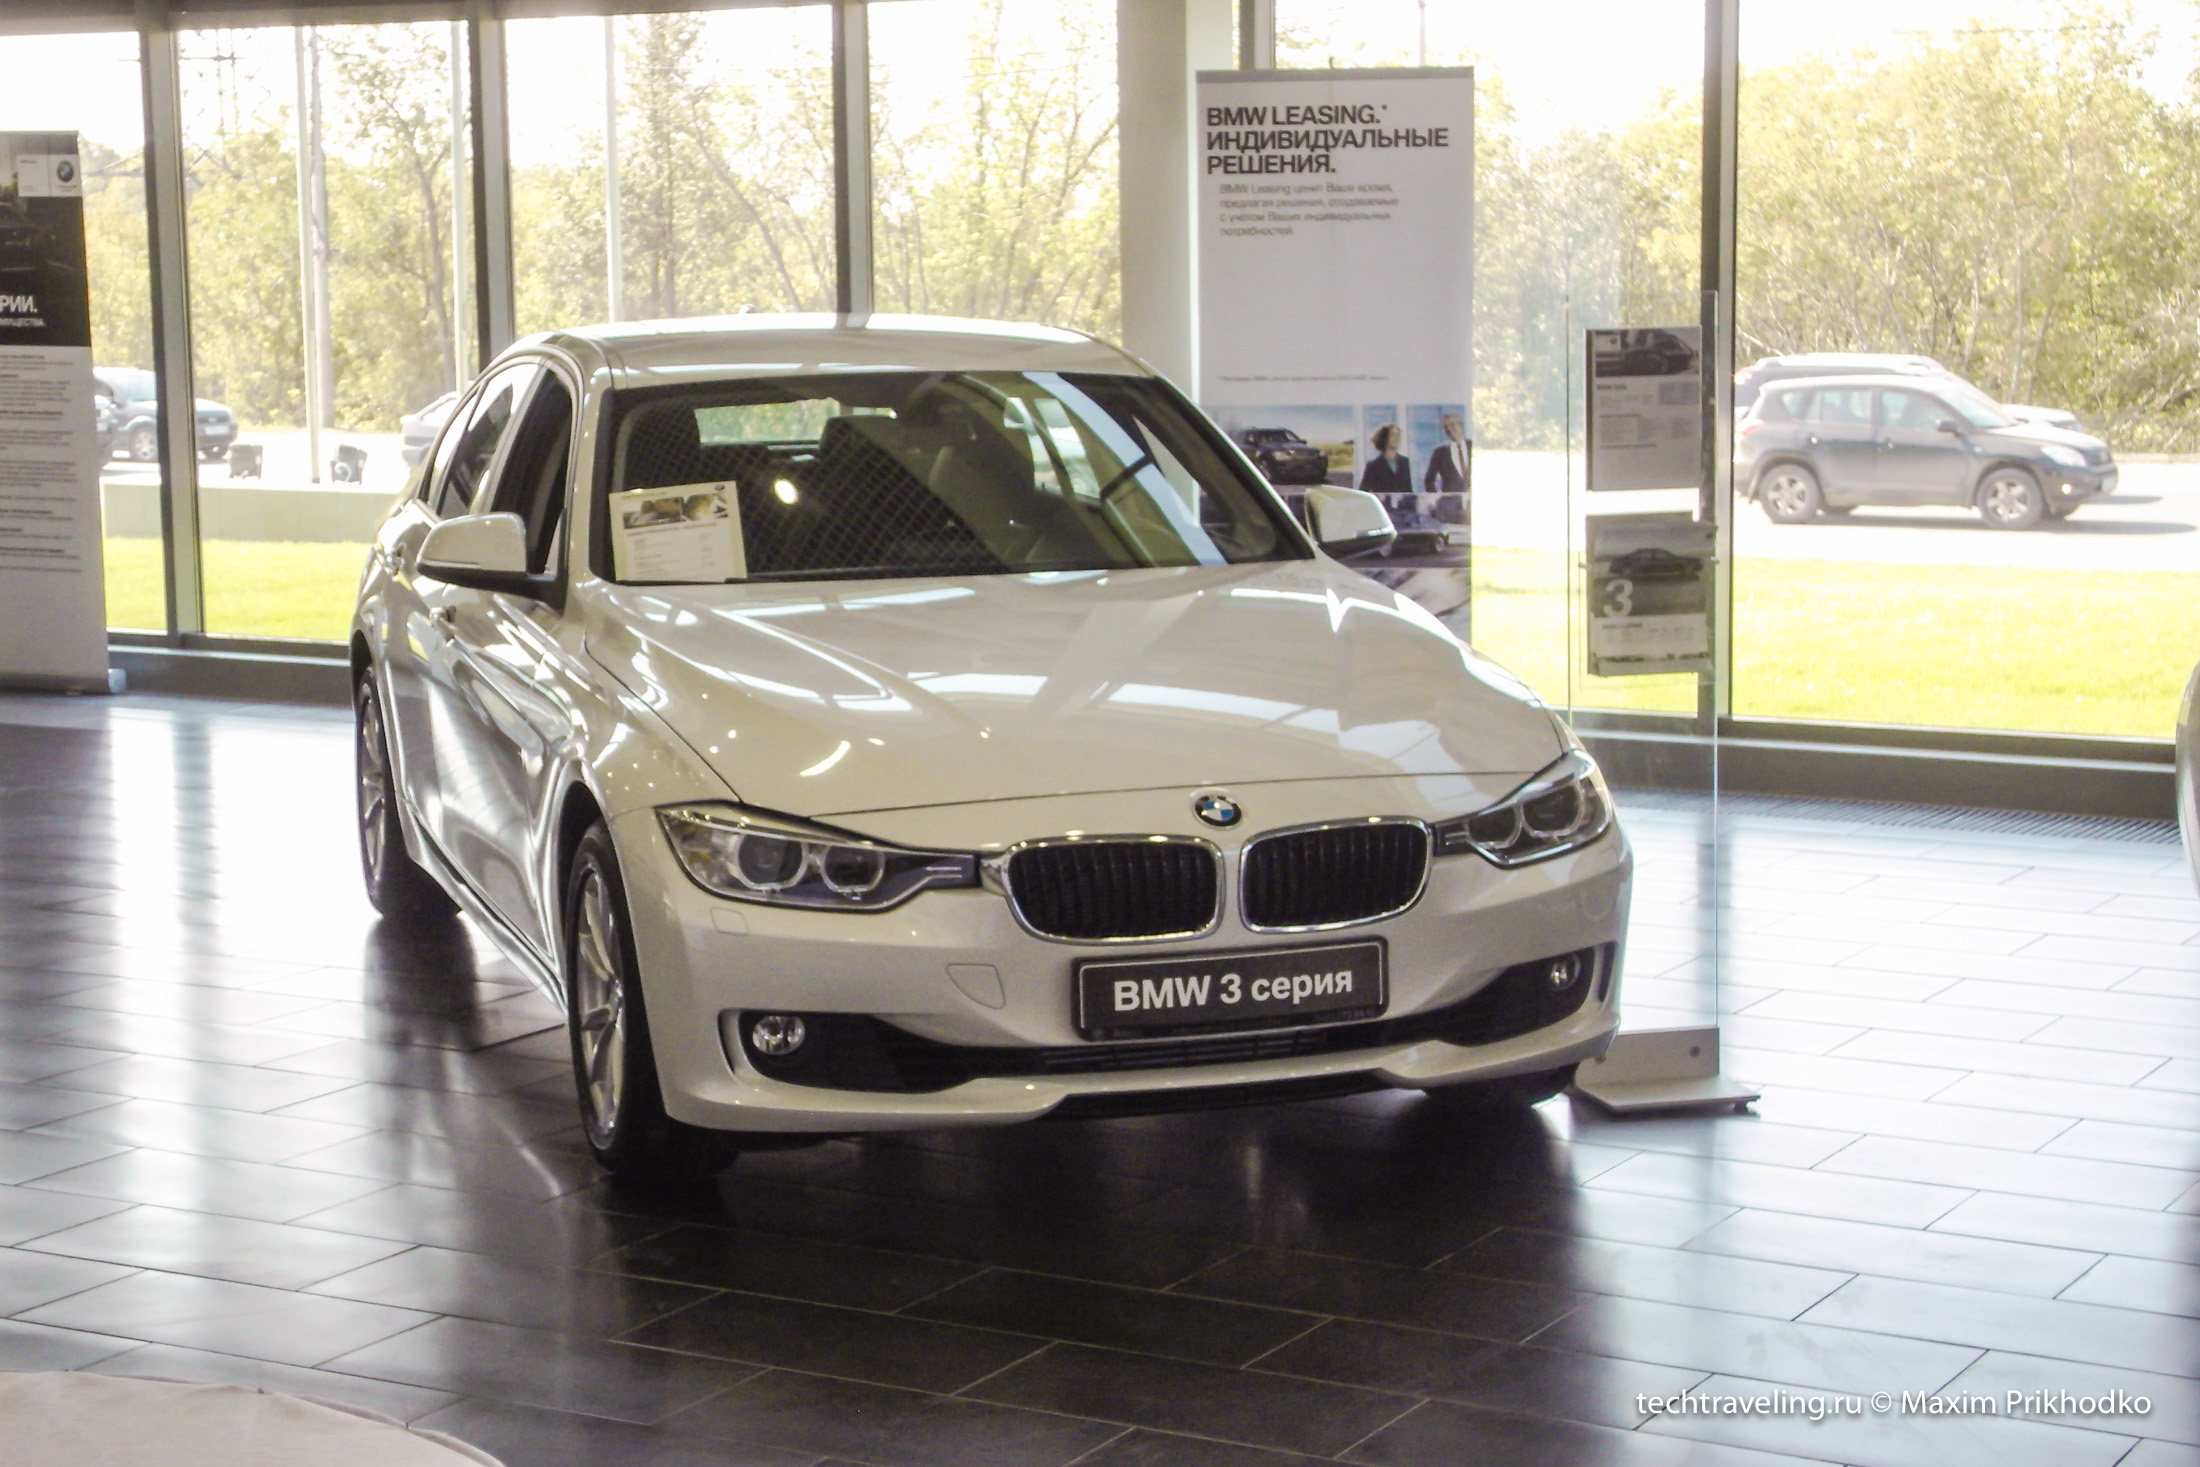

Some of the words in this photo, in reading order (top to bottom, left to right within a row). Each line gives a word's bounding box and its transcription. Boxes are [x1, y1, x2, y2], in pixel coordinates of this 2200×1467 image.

[1207, 107, 1266, 126] BMW
[1207, 128, 1449, 153] ИНДИВИДУАЛЬНЫЕ
[1207, 154, 1337, 174] РЕШЕНИЯ.
[1219, 184, 1248, 194] BMW
[1604, 579, 1634, 617] 3
[1114, 975, 1210, 1012] BMW
[1220, 973, 1242, 1004] 3
[1251, 970, 1354, 1005] серия
